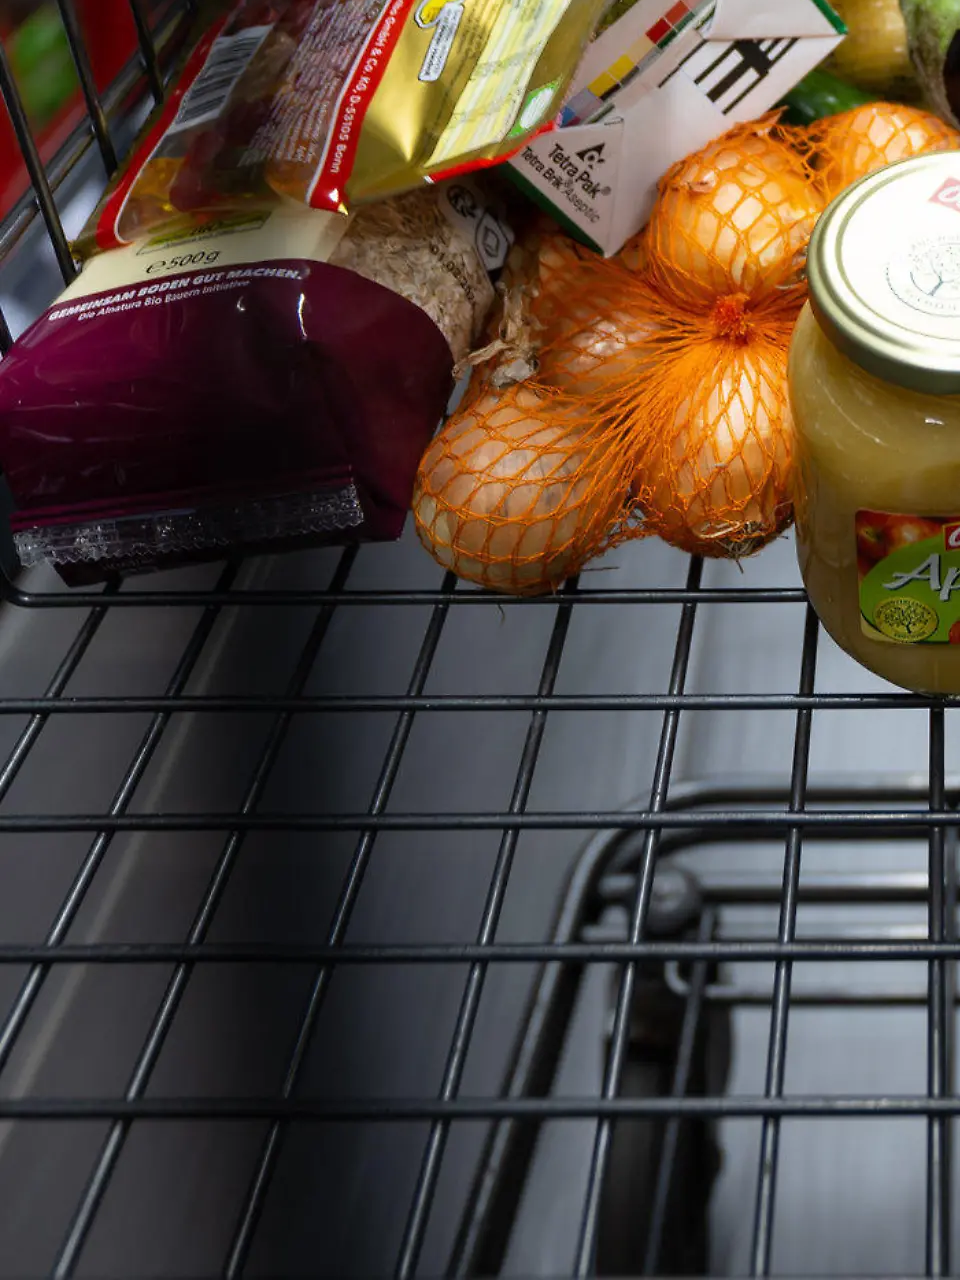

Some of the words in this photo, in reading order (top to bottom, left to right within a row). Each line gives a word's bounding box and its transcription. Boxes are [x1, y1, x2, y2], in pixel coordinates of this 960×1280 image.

[375, 17, 396, 47] GmbH
[330, 144, 347, 172] Bonn
[546, 143, 583, 179] Tetra
[520, 146, 548, 173] Tetra
[562, 186, 601, 224] Aseptic
[49, 290, 135, 321] GEMEINSAM
[137, 277, 190, 296] BODEN
[192, 273, 221, 285] GUT
[97, 300, 141, 315] Alnatura
[143, 296, 161, 307] Bio
[164, 289, 200, 303] Bauern
